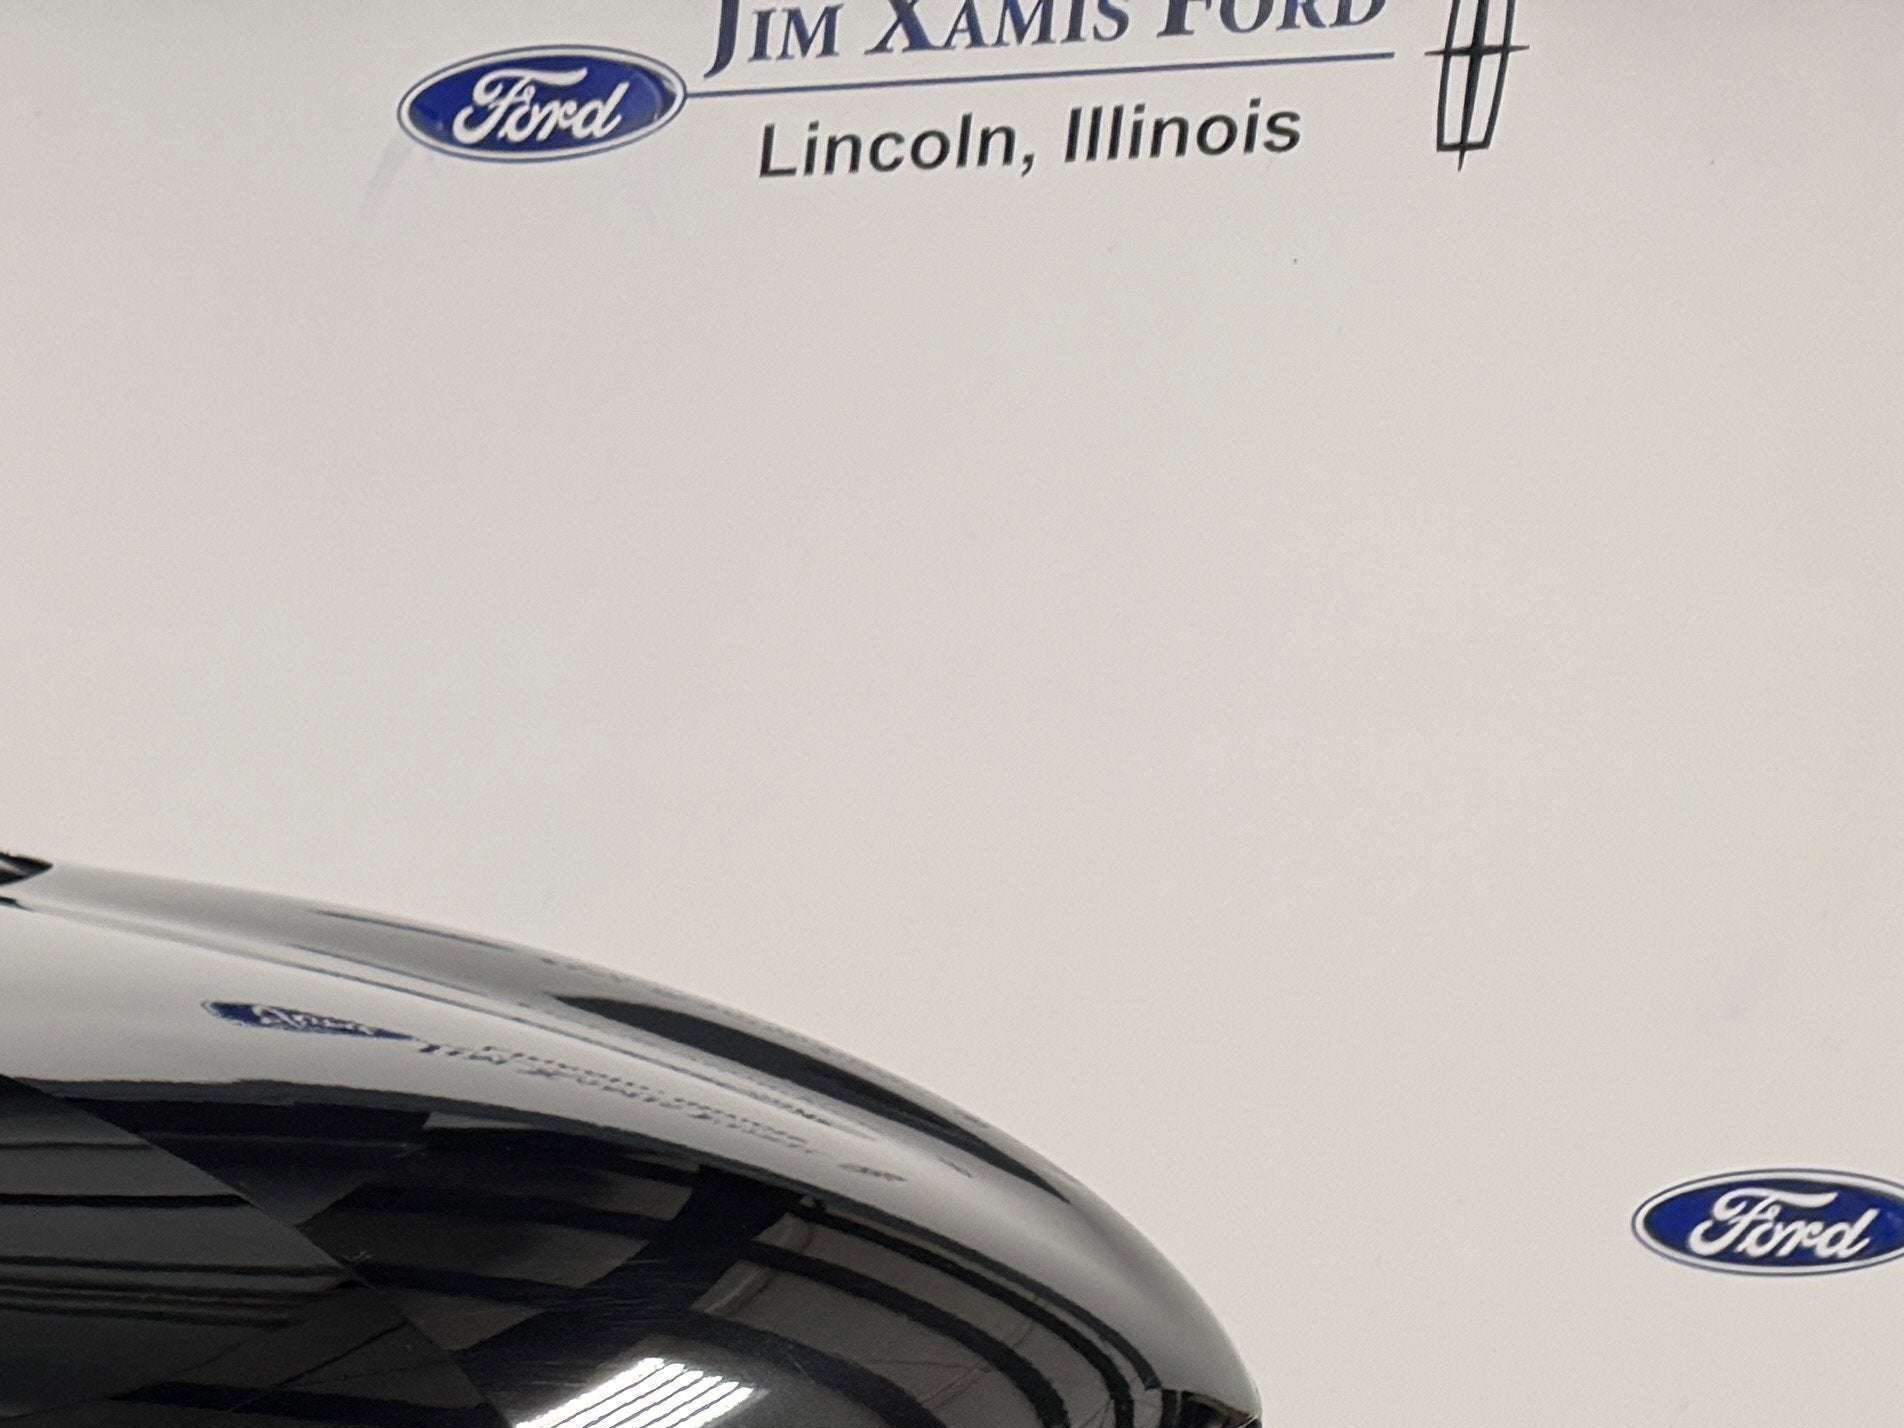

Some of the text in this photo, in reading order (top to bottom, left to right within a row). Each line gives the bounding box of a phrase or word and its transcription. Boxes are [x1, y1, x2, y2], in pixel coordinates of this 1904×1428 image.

[453, 67, 630, 144] Ford
[759, 97, 1302, 178] Lincoln, Illinois
[1687, 1187, 1880, 1258] Ford
